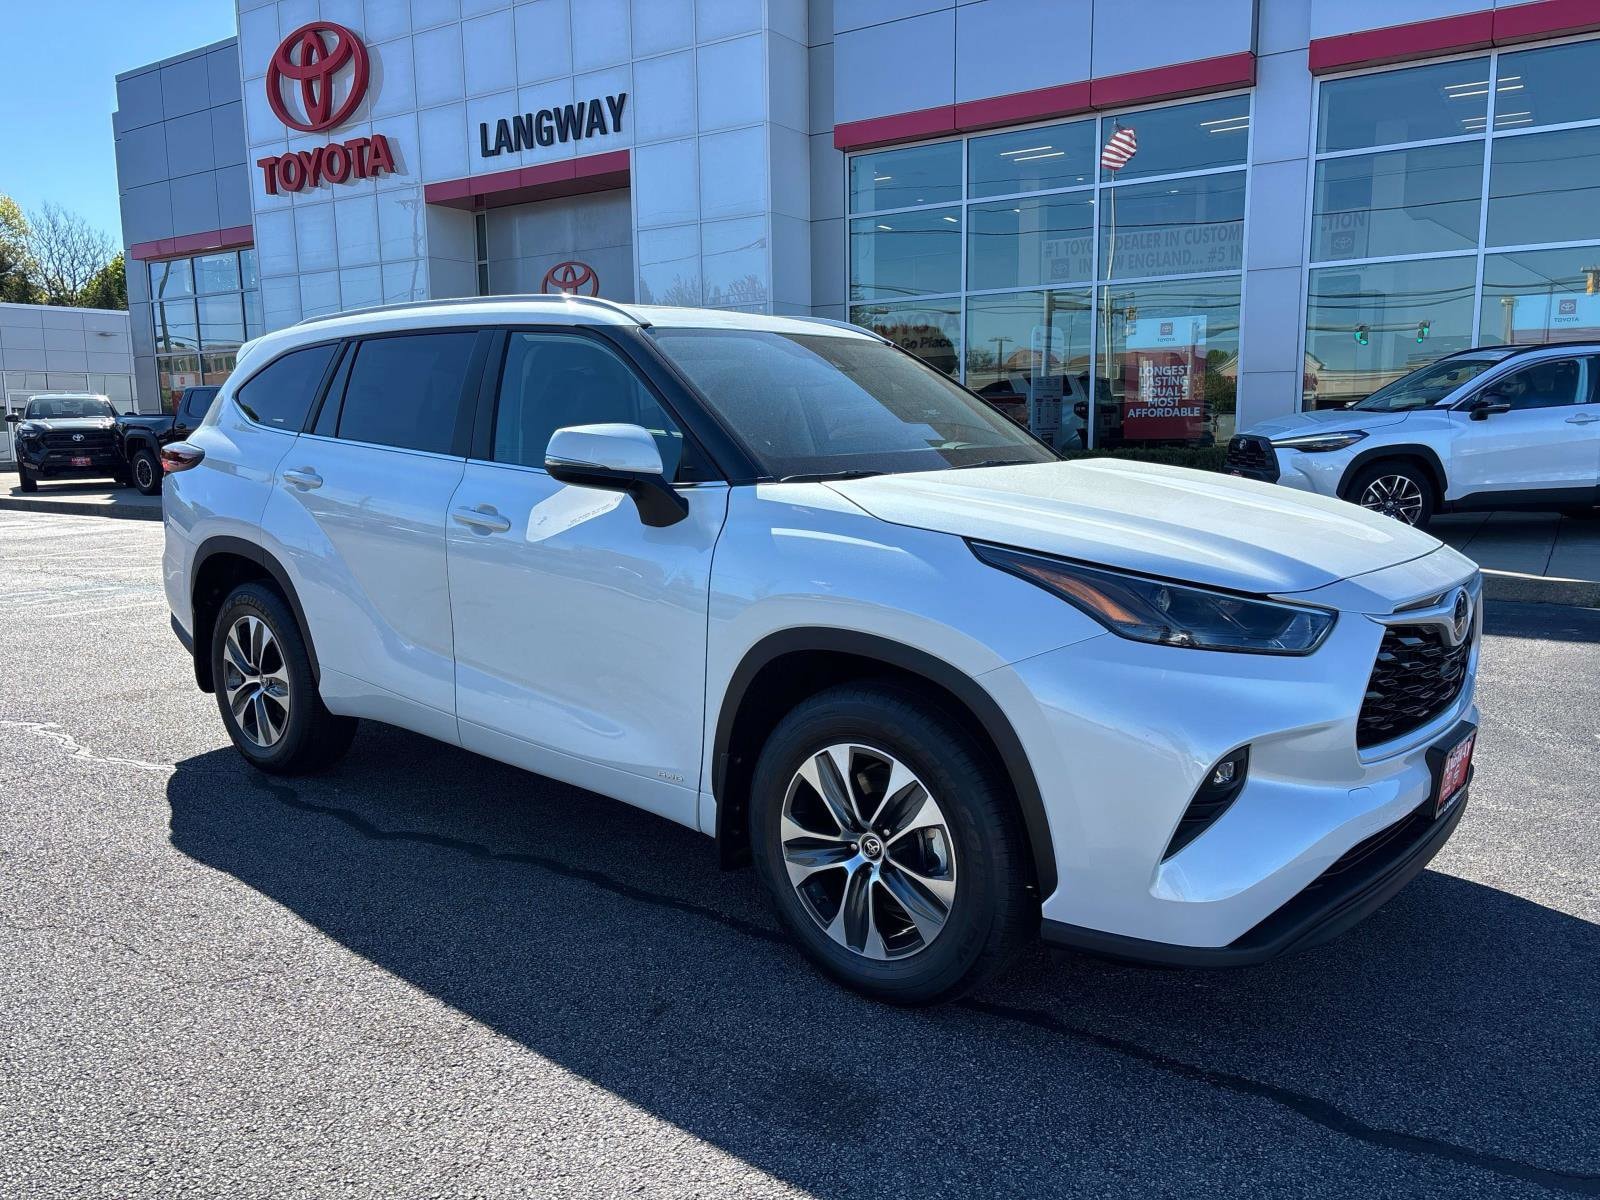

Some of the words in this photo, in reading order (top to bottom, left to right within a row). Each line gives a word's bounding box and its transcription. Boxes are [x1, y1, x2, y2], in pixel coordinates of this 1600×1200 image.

[480, 93, 626, 157] LANGWAY
[257, 134, 395, 195] TOYOTA
[1045, 241, 1059, 258] #1
[1116, 231, 1160, 251] DEALER
[1165, 230, 1180, 247] IN
[1184, 224, 1243, 245] CUSTOM
[1208, 245, 1226, 263] #5
[1140, 365, 1191, 376] LONGEST
[1140, 376, 1189, 387] LASTING
[1140, 386, 1189, 398] EQUALS
[1147, 397, 1180, 408] MOST
[1127, 406, 1201, 418] AFFORDABLE
